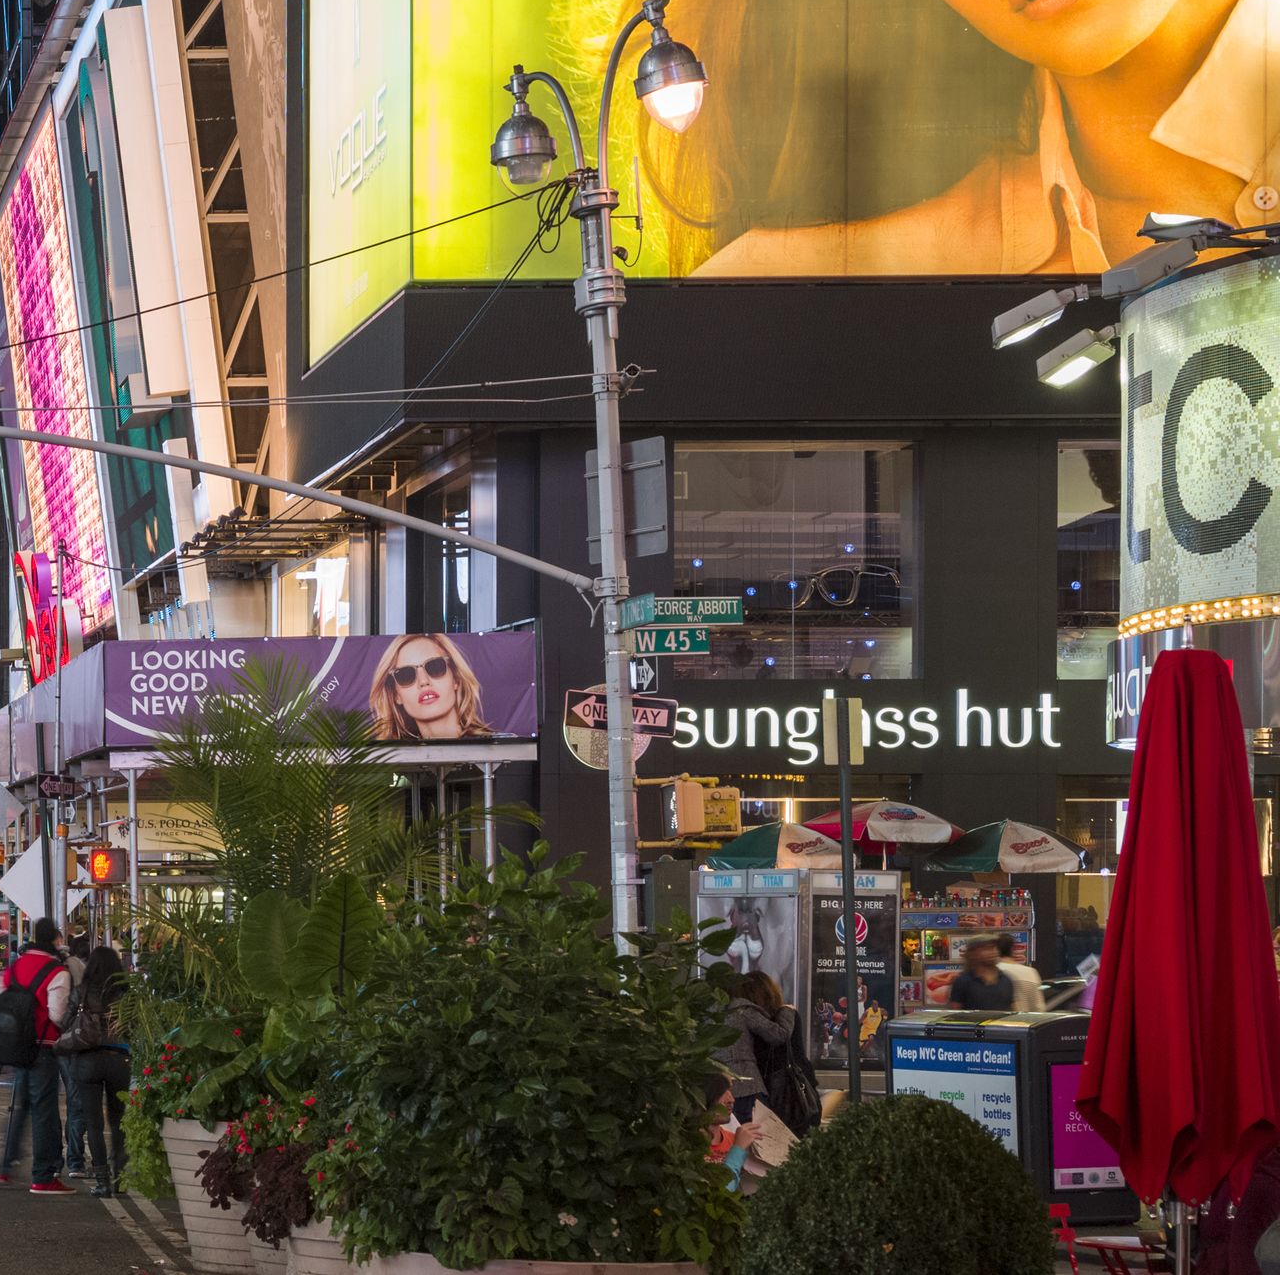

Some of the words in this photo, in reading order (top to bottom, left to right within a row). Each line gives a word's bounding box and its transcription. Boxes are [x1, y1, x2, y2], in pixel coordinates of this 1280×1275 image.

[652, 600, 693, 616] GEORGE
[697, 600, 739, 616] ABBOTT
[636, 630, 656, 652] W
[664, 630, 690, 651] 45
[695, 630, 707, 641] St
[130, 648, 246, 671] LOOKING
[130, 671, 208, 693] GOOD
[131, 694, 188, 716] NEW
[582, 702, 608, 720] ONE
[955, 688, 1061, 749] hut
[136, 818, 157, 829] U.S.
[159, 818, 191, 829] POLO
[713, 876, 733, 887] TITAN
[762, 876, 784, 887] TITAN
[820, 899, 840, 910] BIG
[864, 900, 884, 910] HERE
[817, 958, 833, 967] 590
[856, 959, 885, 968] Avenue
[896, 1046, 918, 1062] Keep
[919, 1047, 936, 1061] NYC
[937, 1048, 964, 1063] Green
[965, 1049, 981, 1063] and
[982, 1050, 1012, 1065] Clean!
[939, 1090, 965, 1102] recycle
[982, 1092, 1012, 1105] recycle
[983, 1107, 1012, 1121] bottles
[992, 1126, 1011, 1138] cans
